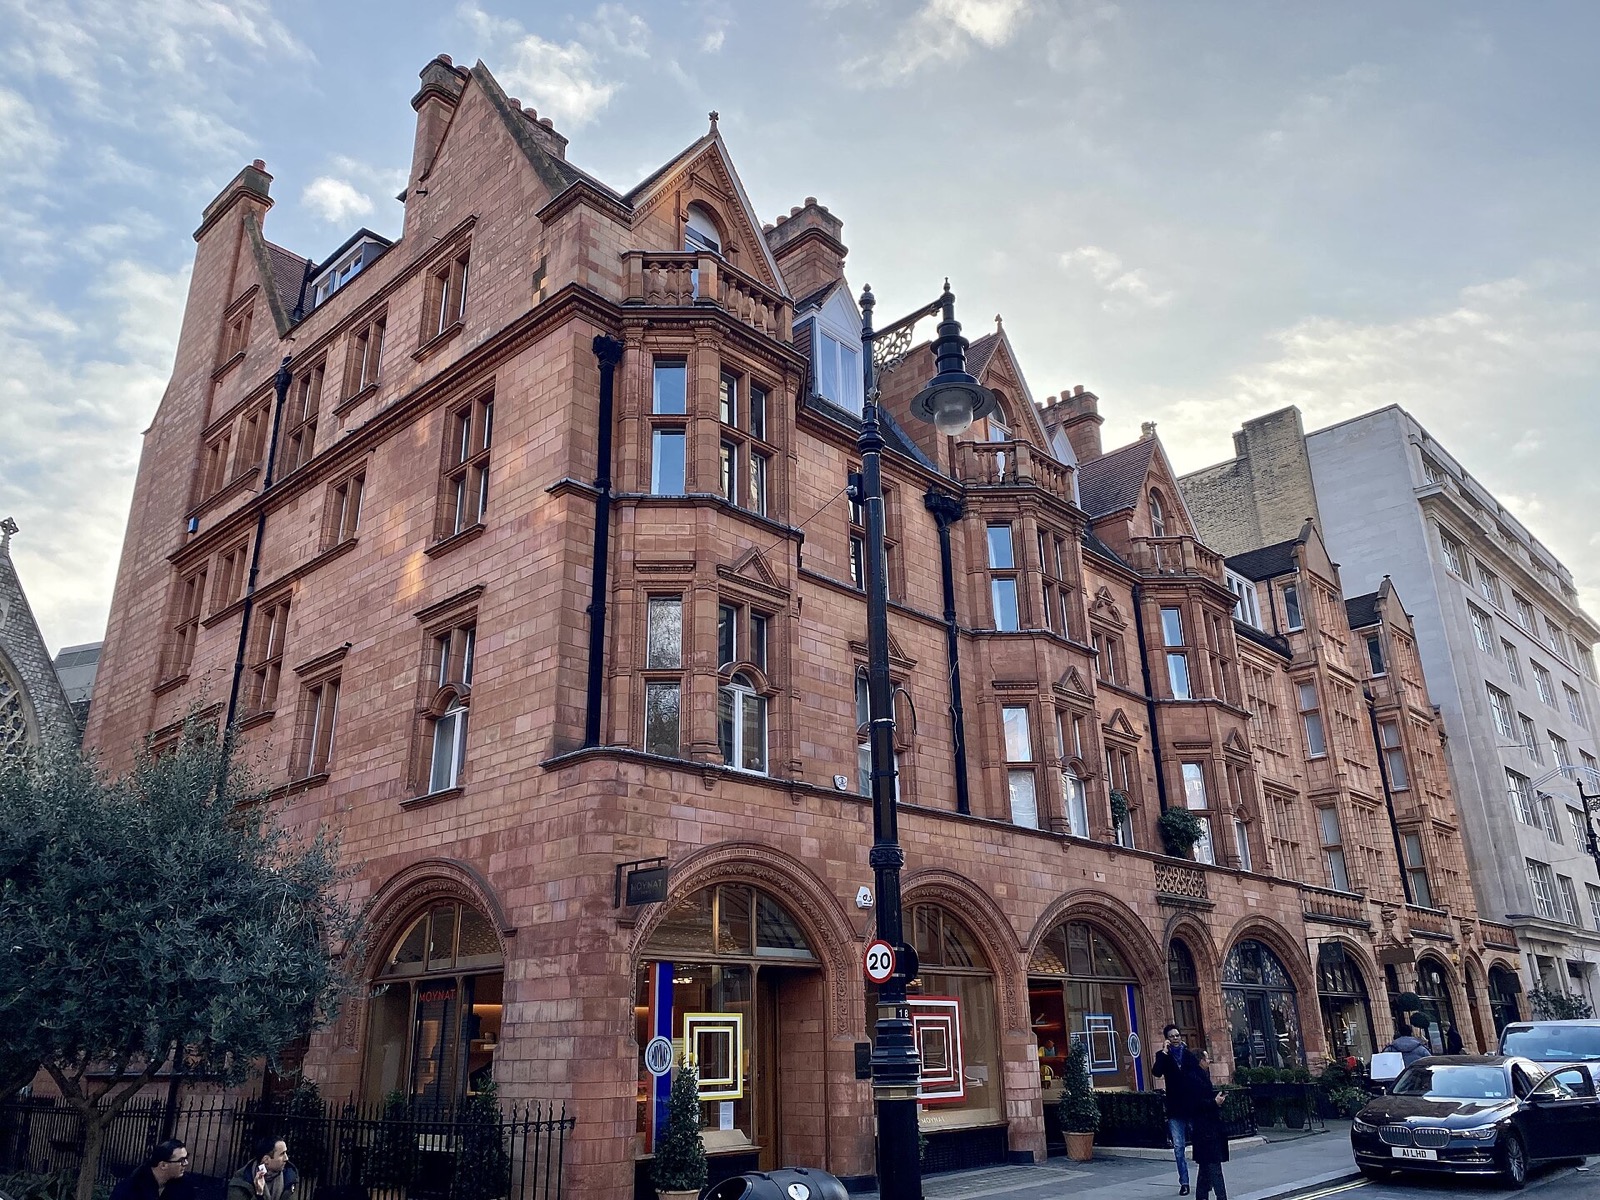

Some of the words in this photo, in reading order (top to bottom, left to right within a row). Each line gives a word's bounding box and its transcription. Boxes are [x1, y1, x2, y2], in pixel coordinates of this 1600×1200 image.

[868, 952, 891, 970] 20
[419, 989, 456, 1002] MOYNAT
[898, 1009, 909, 1018] 18
[1411, 1149, 1427, 1158] LHD
